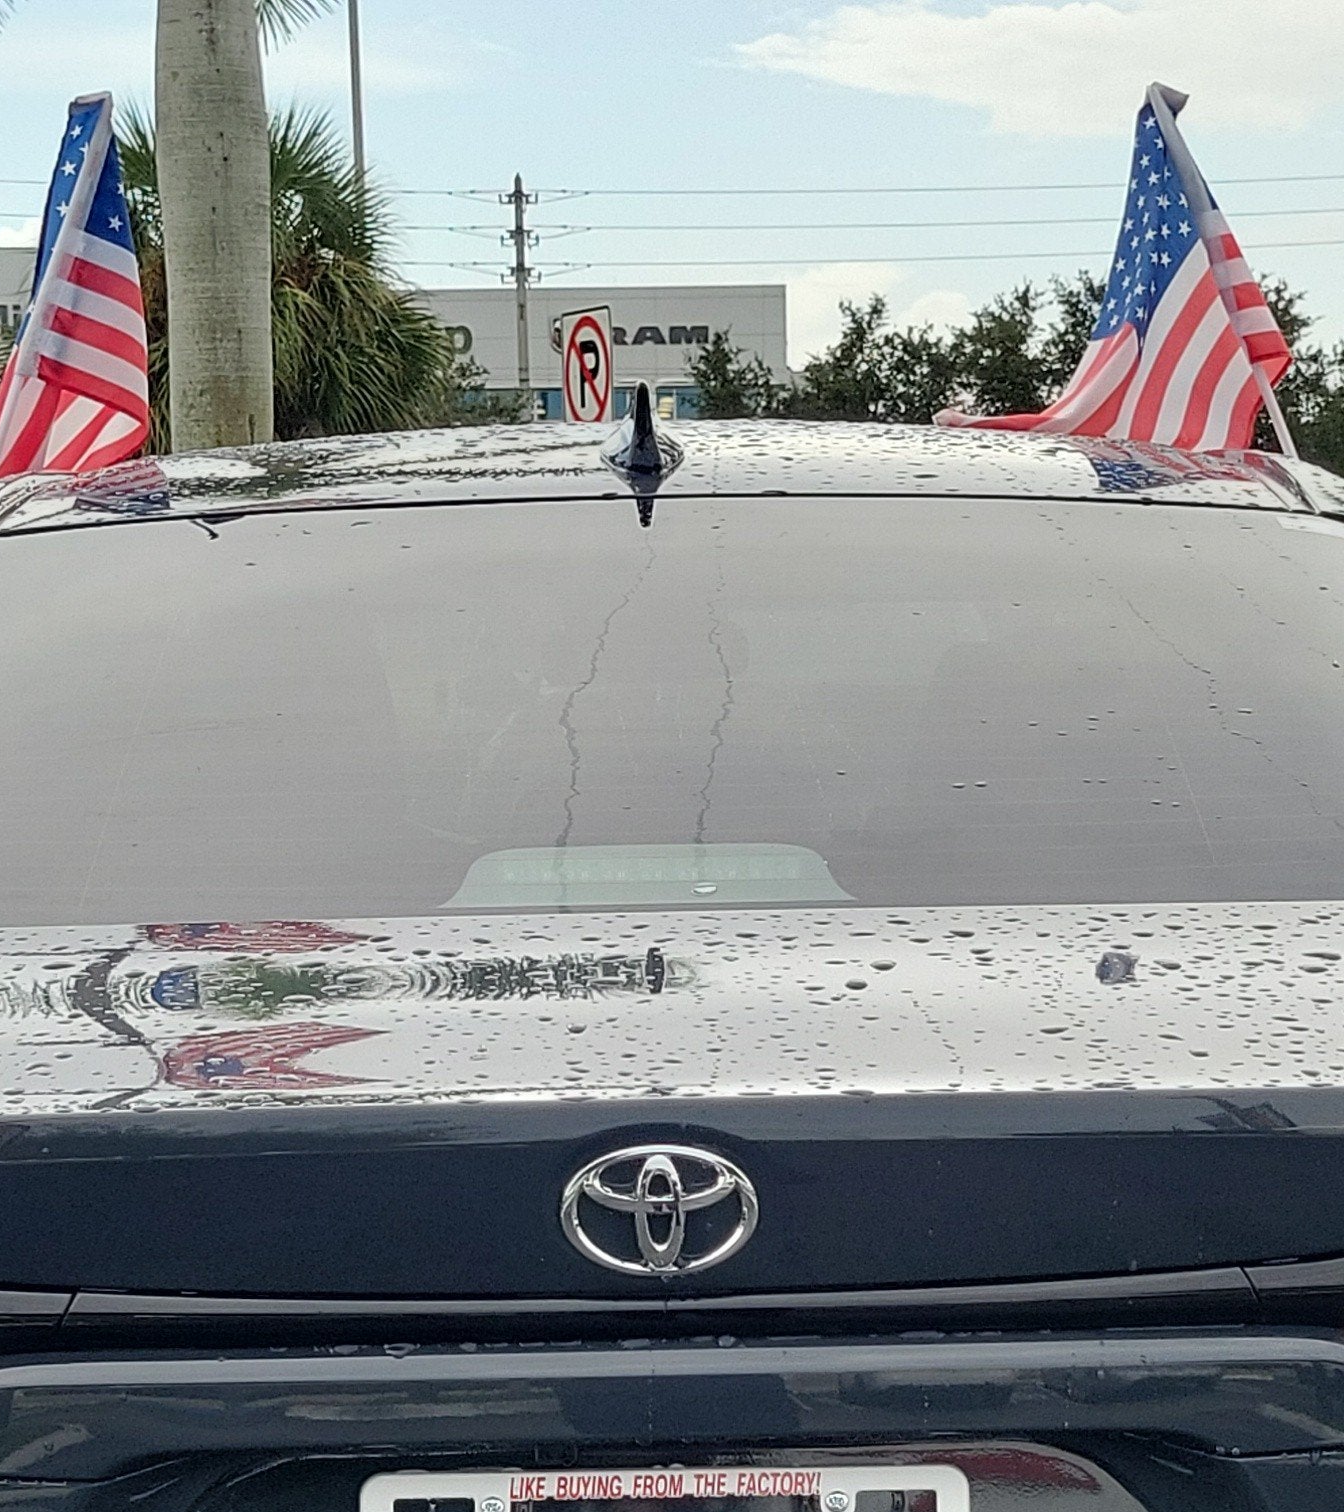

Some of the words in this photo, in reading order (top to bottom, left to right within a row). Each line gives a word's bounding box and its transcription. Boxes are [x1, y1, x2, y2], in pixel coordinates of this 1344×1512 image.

[612, 325, 710, 346] RAM
[509, 1476, 546, 1499] LIKE
[556, 1474, 622, 1498] BUYING
[633, 1473, 684, 1497] FROM
[693, 1472, 727, 1496] THE
[737, 1471, 822, 1495] FACTORY!
